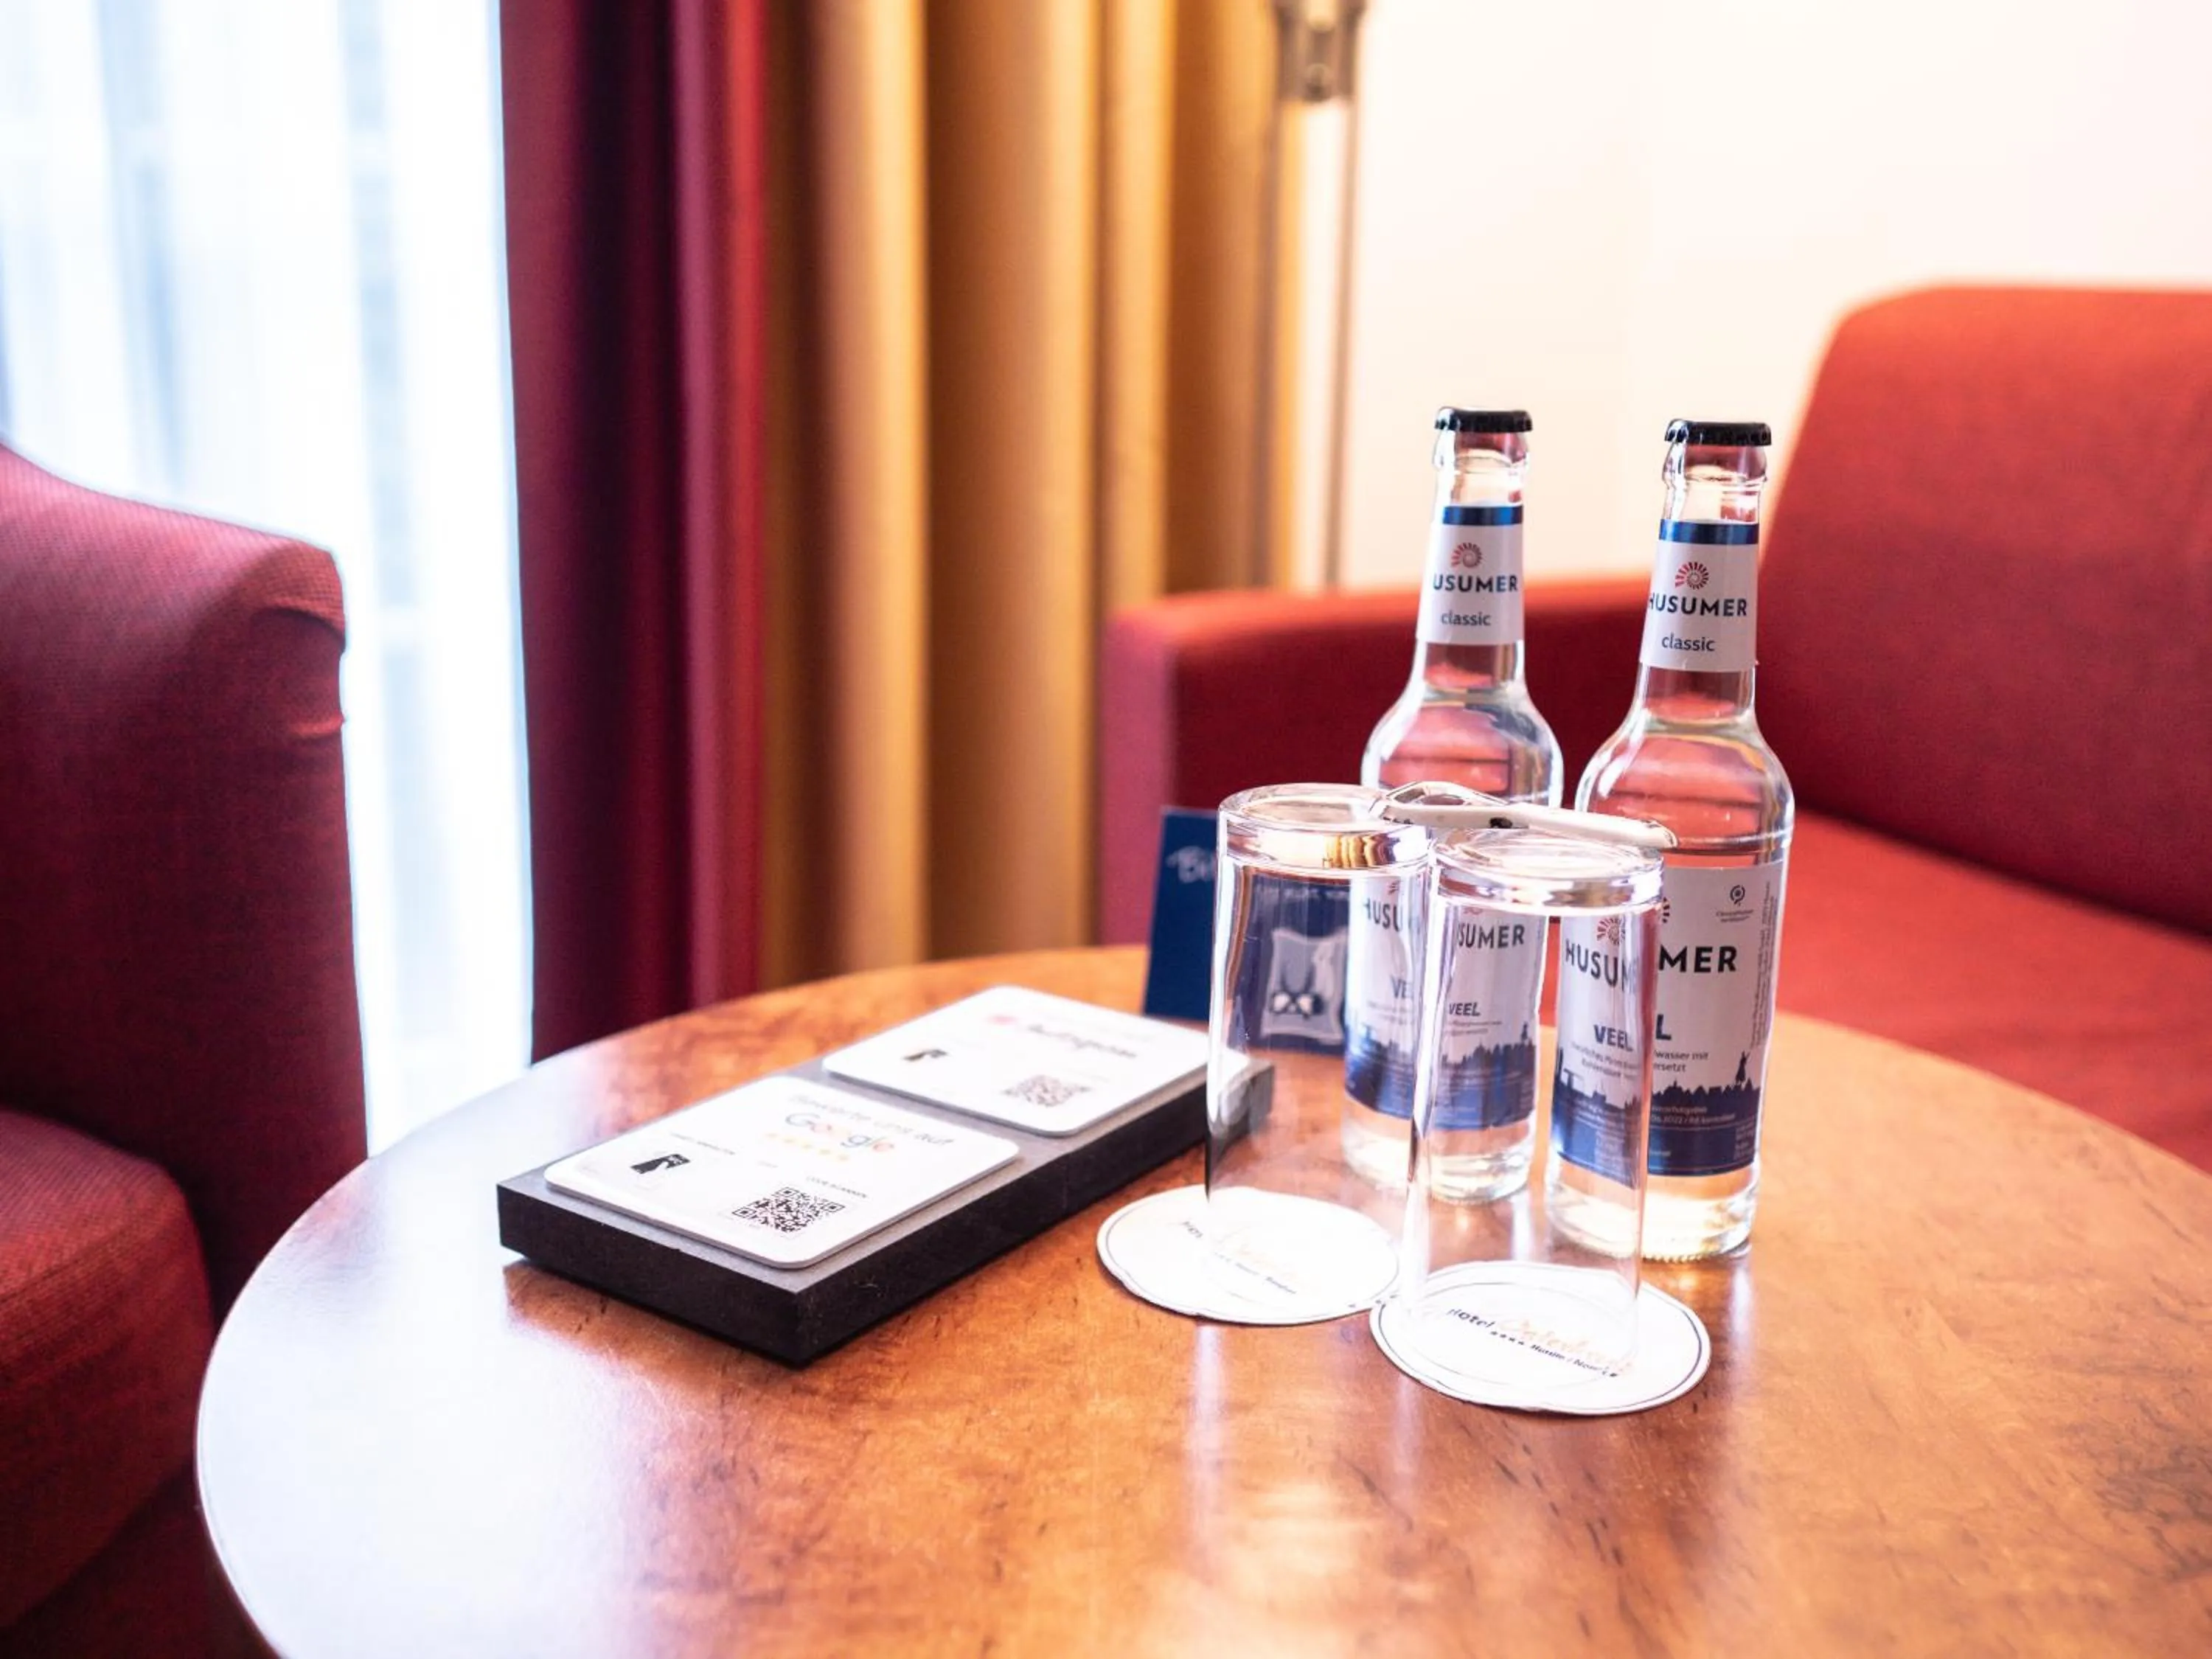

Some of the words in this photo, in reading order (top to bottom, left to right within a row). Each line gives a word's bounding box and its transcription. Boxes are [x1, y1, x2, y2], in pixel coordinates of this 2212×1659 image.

[1441, 611, 1492, 626] classic
[1661, 633, 1716, 652] classic
[1449, 1002, 1481, 1017] VEEL
[1593, 1024, 1633, 1052] VEEL
[785, 1113, 895, 1152] Google
